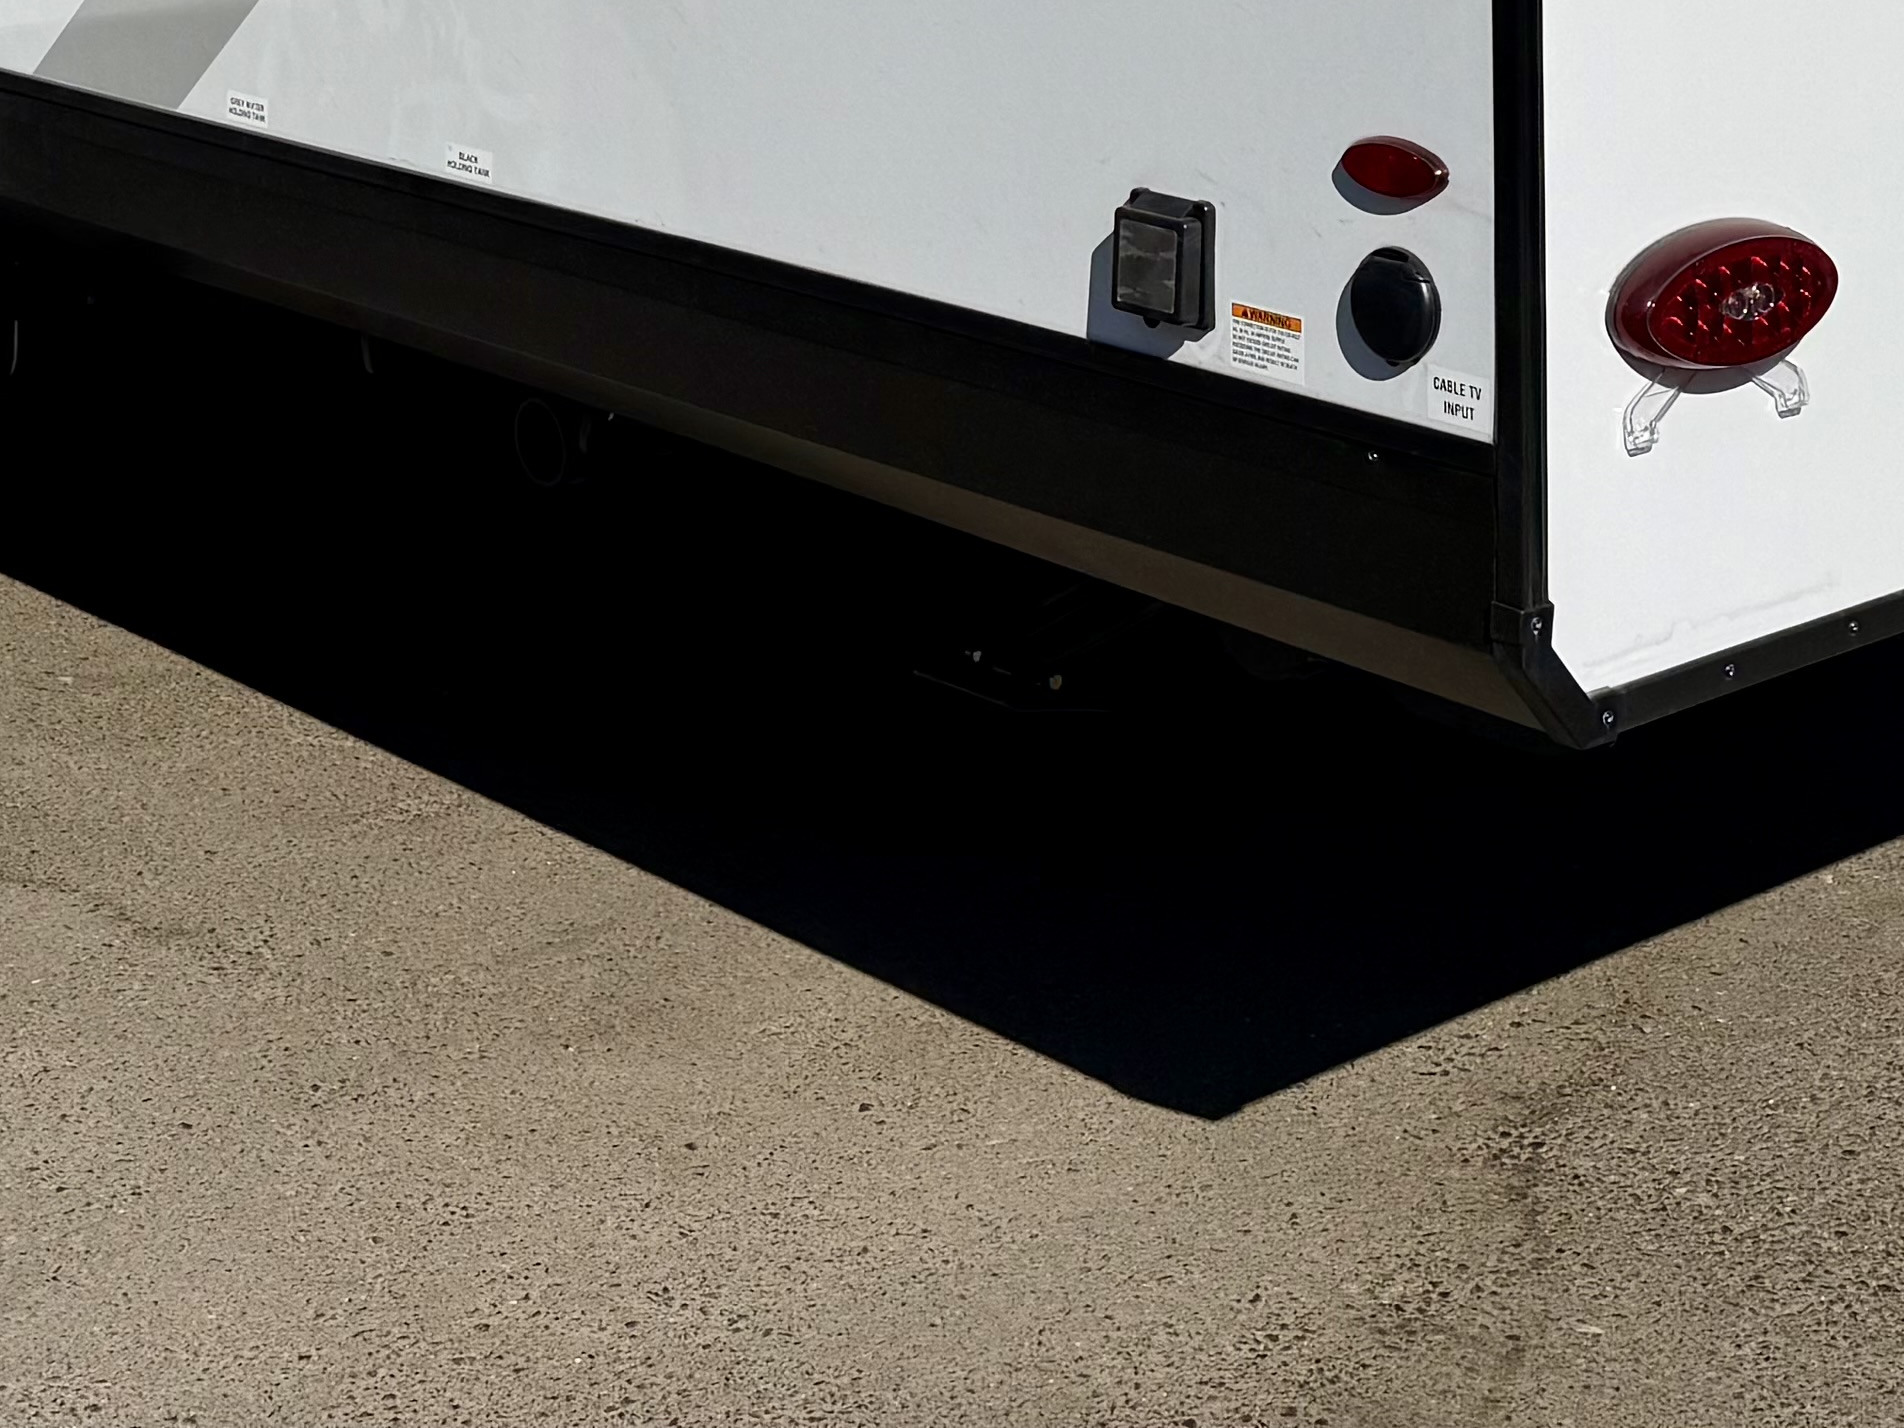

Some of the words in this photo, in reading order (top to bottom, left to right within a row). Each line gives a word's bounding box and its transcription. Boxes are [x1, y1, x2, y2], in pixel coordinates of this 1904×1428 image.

[458, 151, 478, 164] BLACK
[1248, 308, 1292, 330] WARNING
[1433, 376, 1466, 397] CABLE
[1468, 384, 1482, 401] TV
[1443, 400, 1475, 421] INPUT
